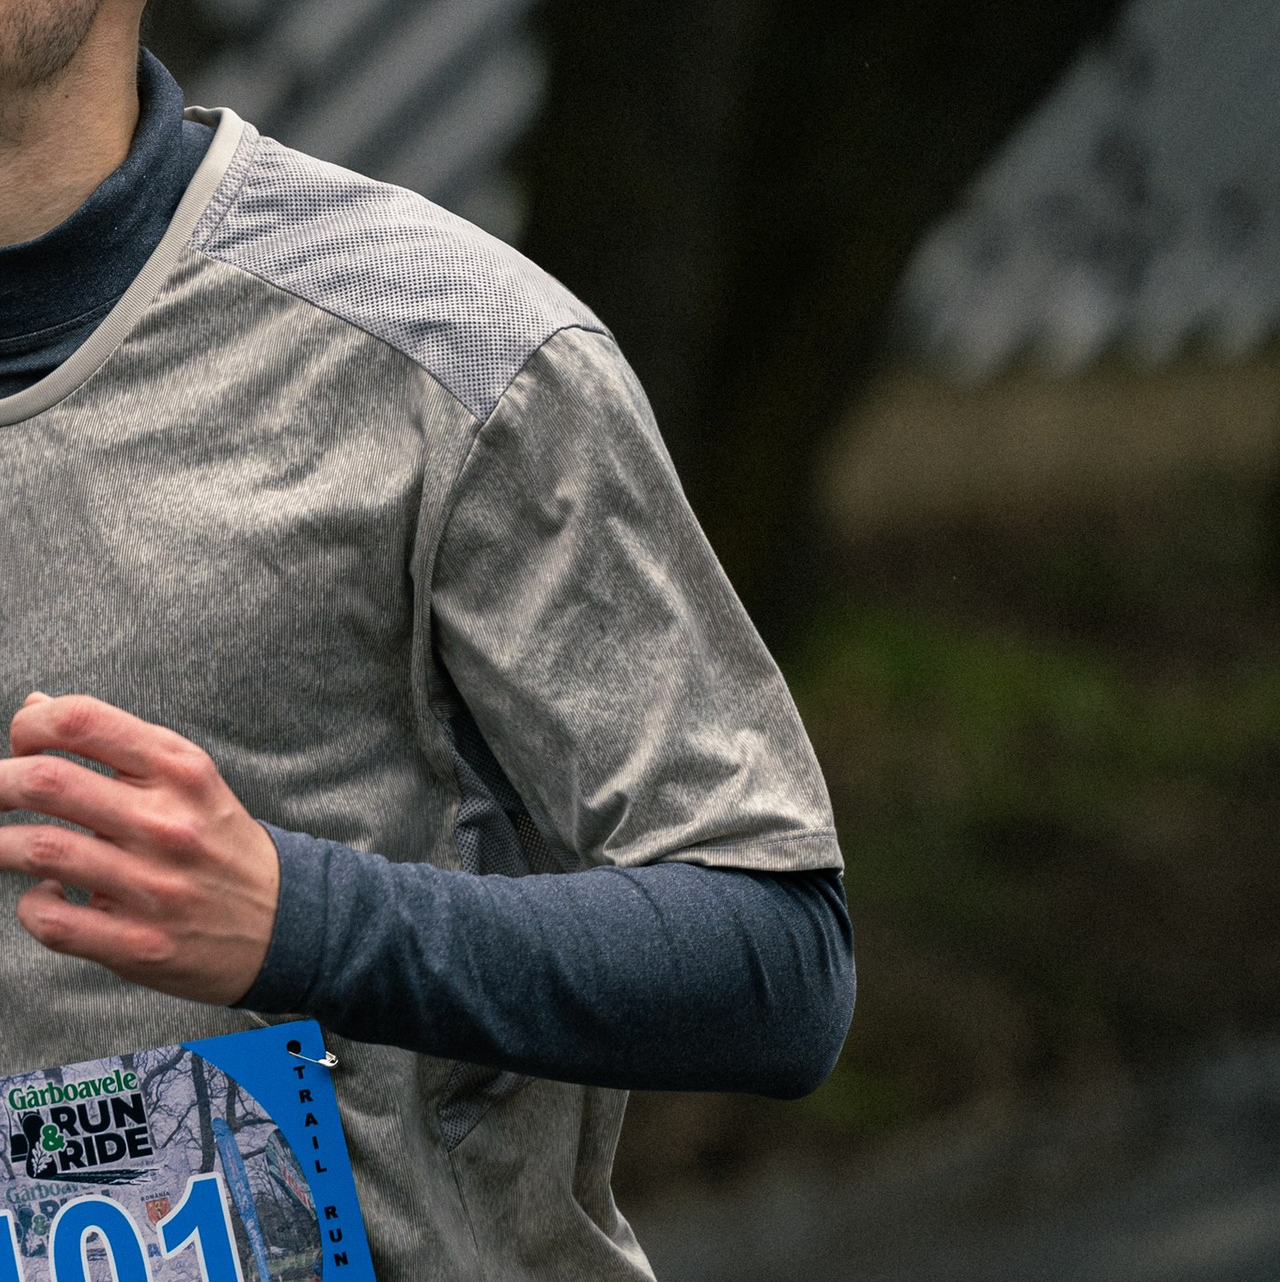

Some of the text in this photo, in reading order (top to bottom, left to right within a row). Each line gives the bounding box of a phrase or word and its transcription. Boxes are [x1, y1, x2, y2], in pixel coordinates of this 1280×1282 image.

[8, 1069, 140, 1110] Gârboavele
[49, 1093, 147, 1138] RUN
[41, 1124, 154, 1172] & RIDE
[293, 1065, 327, 1174] TRAIL
[324, 1206, 349, 1267] RUN
